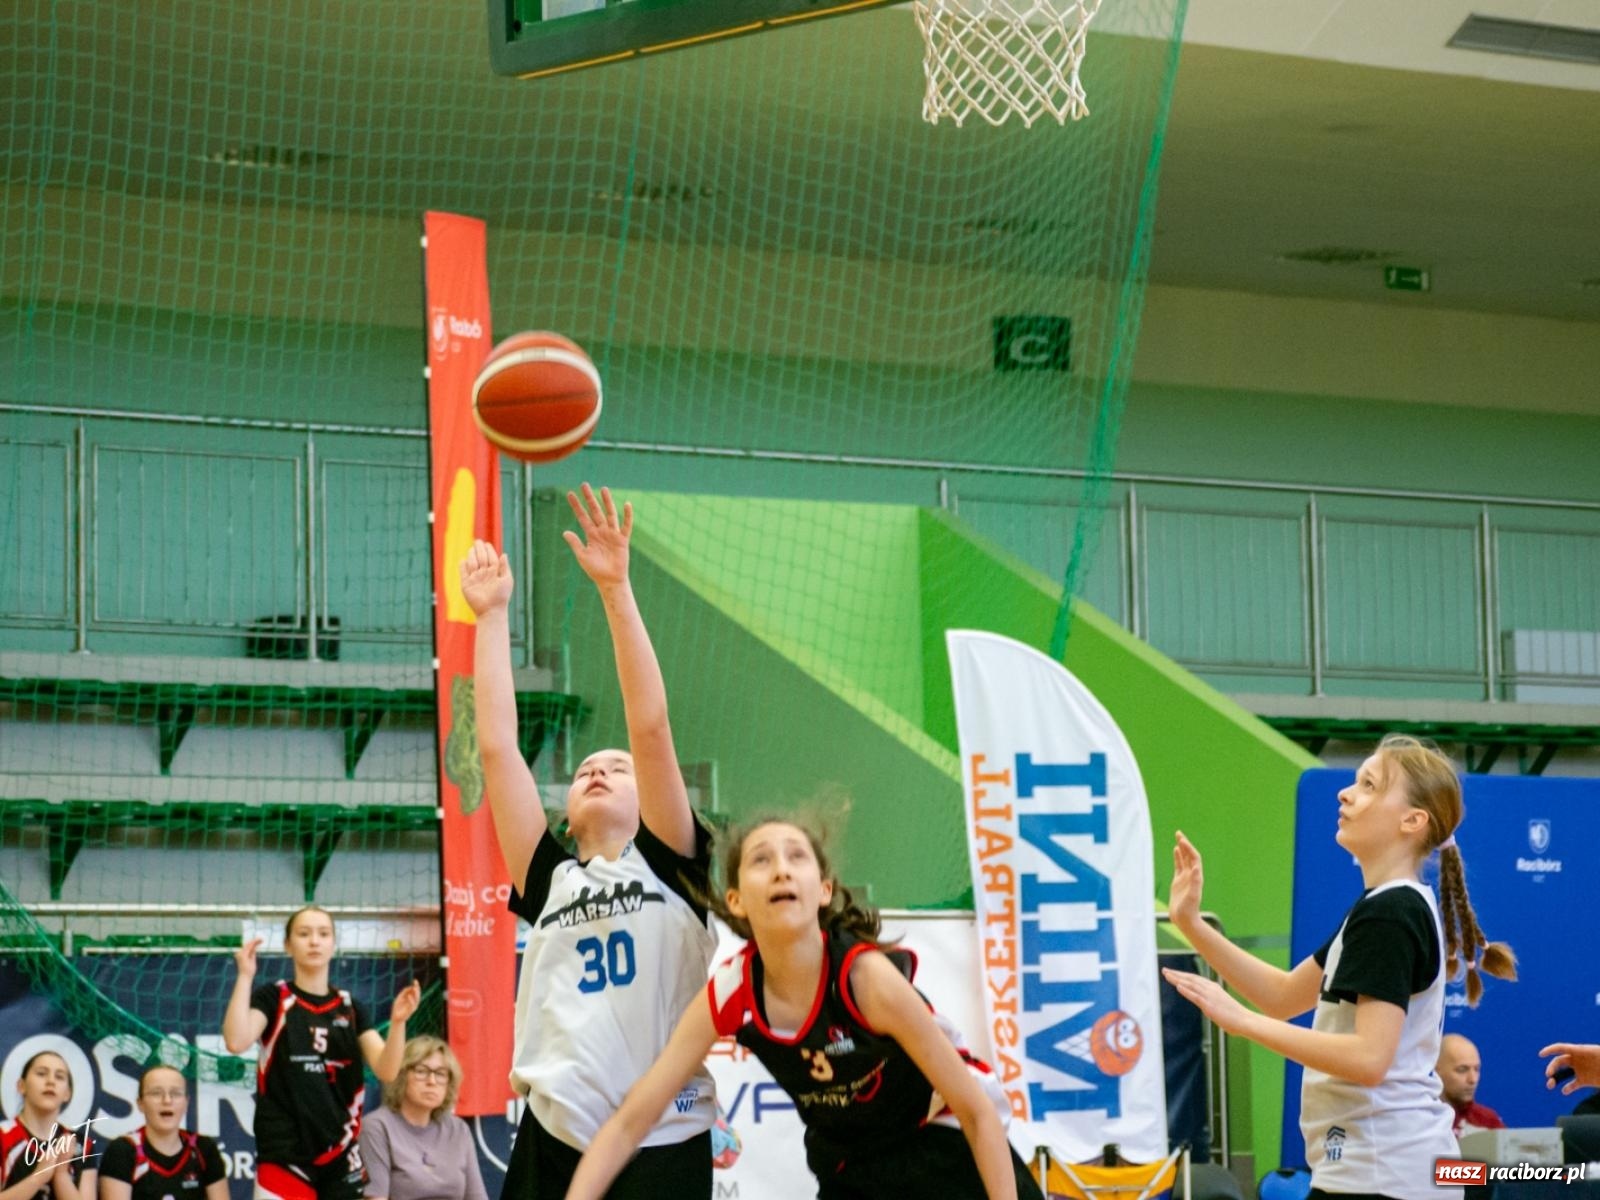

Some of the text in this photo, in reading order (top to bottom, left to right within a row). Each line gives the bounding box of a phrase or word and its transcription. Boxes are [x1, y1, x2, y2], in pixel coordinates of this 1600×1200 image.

[1010, 335, 1050, 363] C
[559, 893, 643, 928] WARSAW
[575, 929, 637, 995] 30
